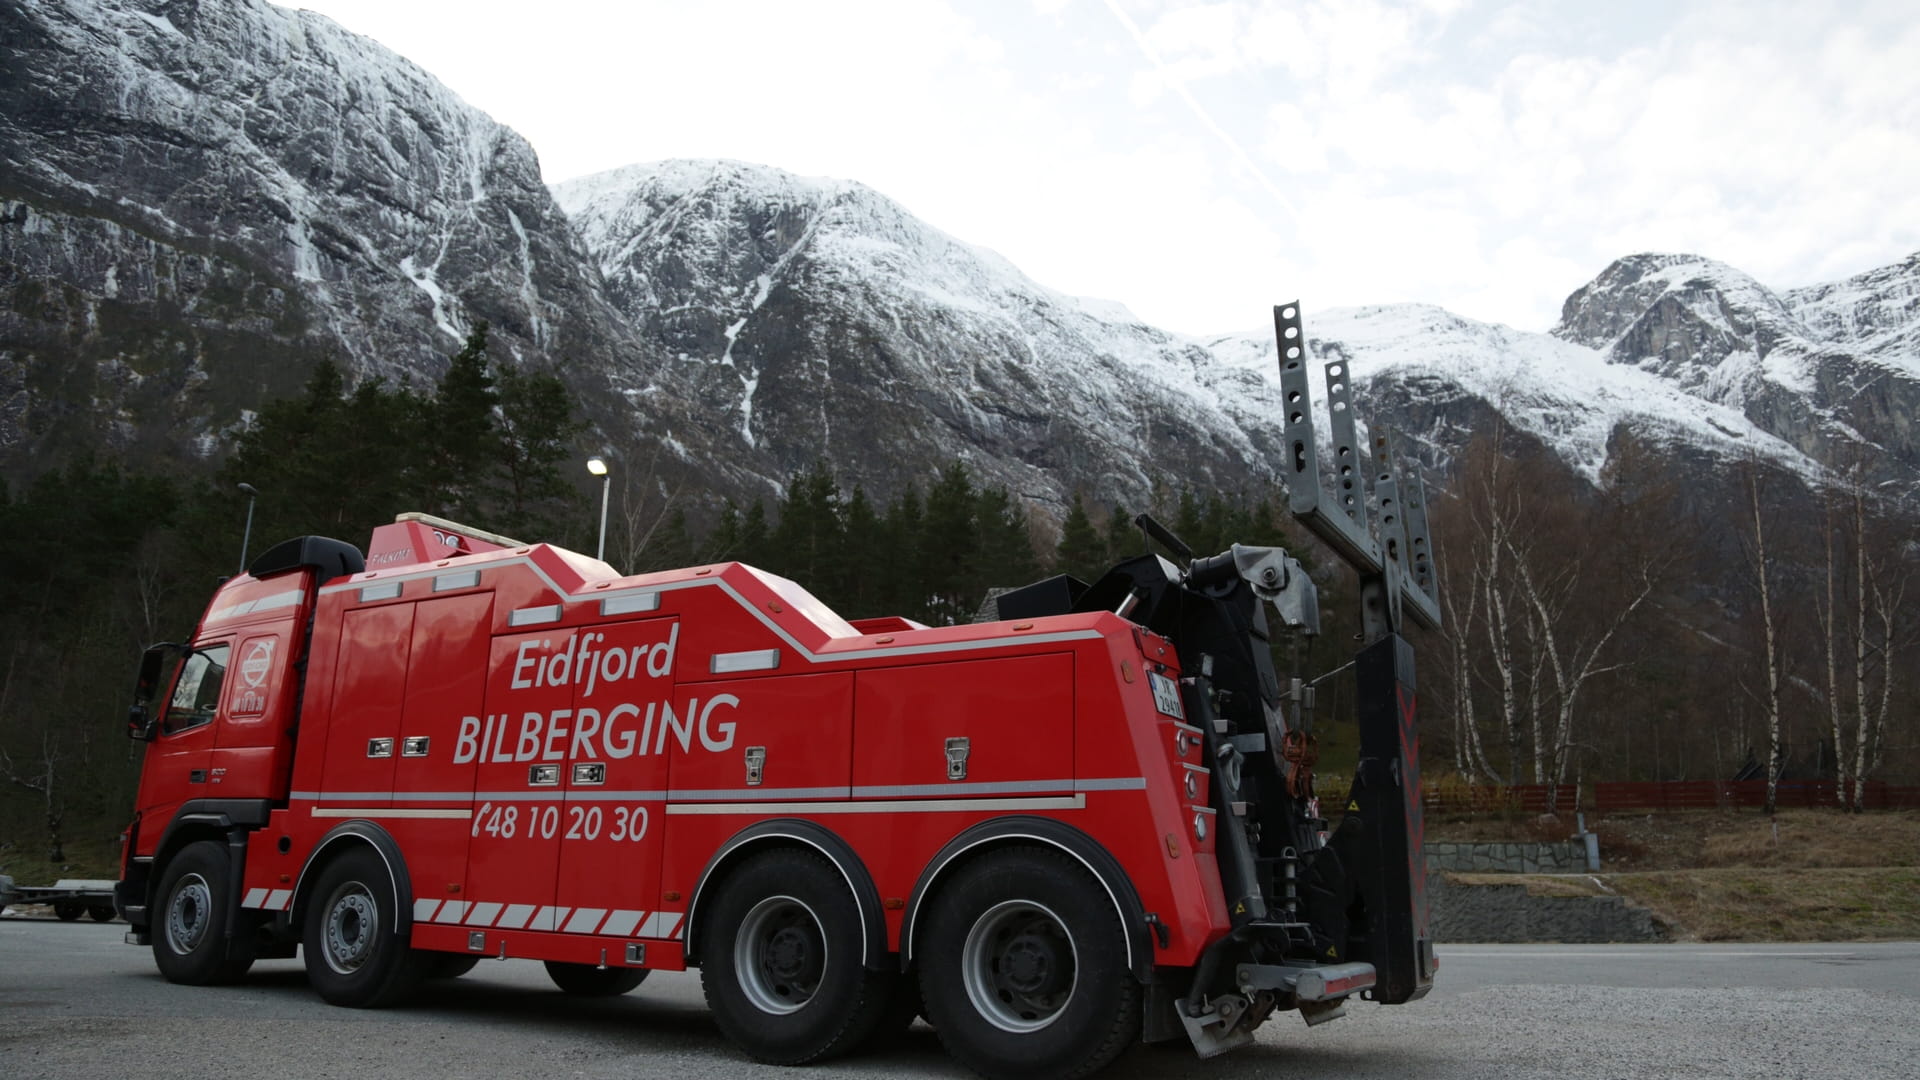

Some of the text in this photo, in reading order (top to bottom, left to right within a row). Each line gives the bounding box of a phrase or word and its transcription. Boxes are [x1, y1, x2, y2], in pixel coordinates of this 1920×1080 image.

[511, 622, 679, 697] Eidfjord
[453, 693, 740, 764] BILBERGING
[485, 805, 648, 841] 48 10 20 30
